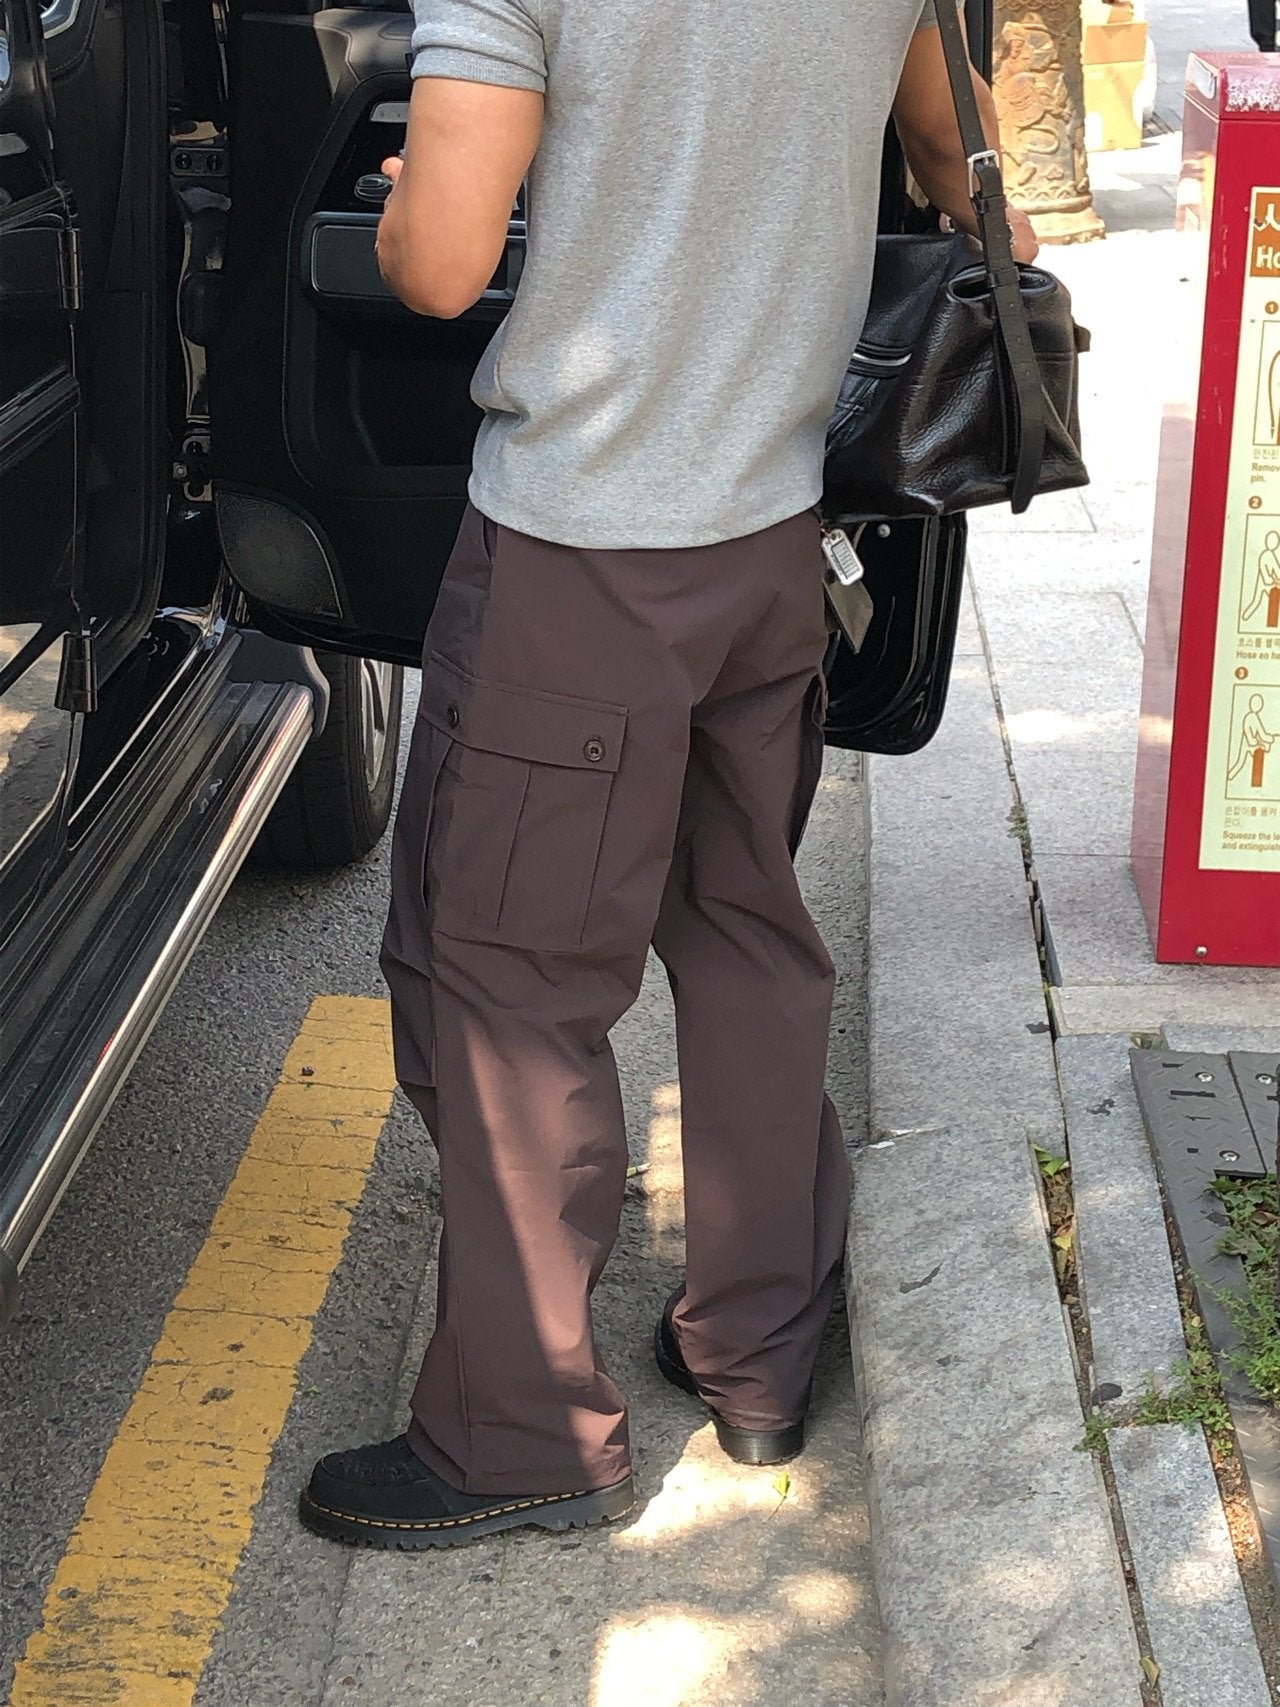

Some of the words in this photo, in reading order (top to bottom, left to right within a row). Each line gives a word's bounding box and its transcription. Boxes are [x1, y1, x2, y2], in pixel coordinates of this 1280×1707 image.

[1236, 650, 1257, 659] Hose
[1223, 830, 1257, 840] Squeeze
[1259, 832, 1271, 840] the
[1222, 841, 1237, 850] and
